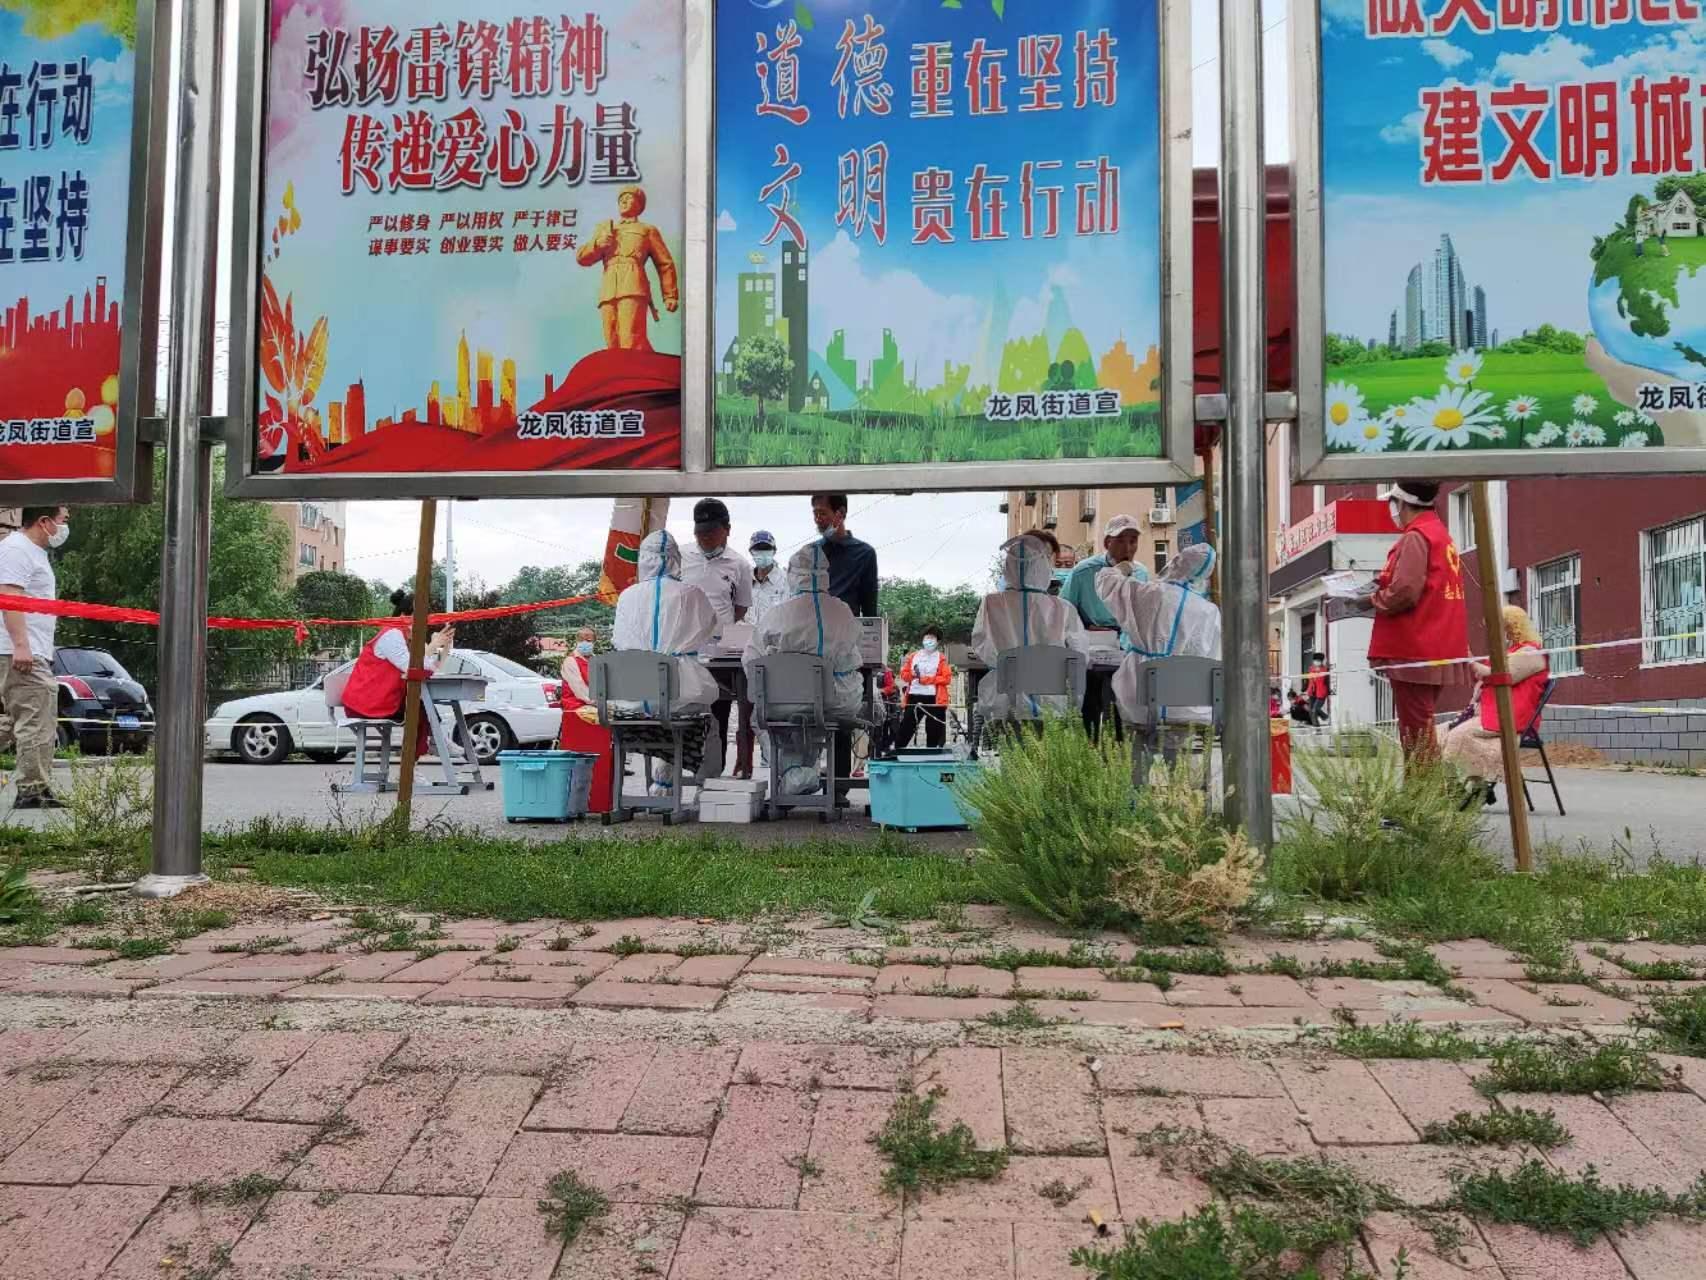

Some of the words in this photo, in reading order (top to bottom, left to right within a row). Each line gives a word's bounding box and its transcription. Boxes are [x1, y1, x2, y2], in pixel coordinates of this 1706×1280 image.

[304, 12, 608, 109] 弘扬雷锋精神
[755, 14, 1118, 126] 道德重在坚持
[338, 101, 642, 194] 传递爱心力量
[1420, 74, 1706, 184] 建文明城
[368, 214, 431, 233] 严以修身
[439, 211, 504, 231] 严以用权
[512, 208, 578, 228] 严于律己
[758, 140, 1121, 251] 文明贵在行动
[368, 238, 431, 257] 谋事要实
[440, 235, 504, 254] 创业要实
[512, 233, 578, 252] 做人要实
[0, 418, 96, 443] 凤街道宣
[519, 412, 643, 437] 龙凤街道宣
[988, 391, 1120, 418] 龙凤街道宣
